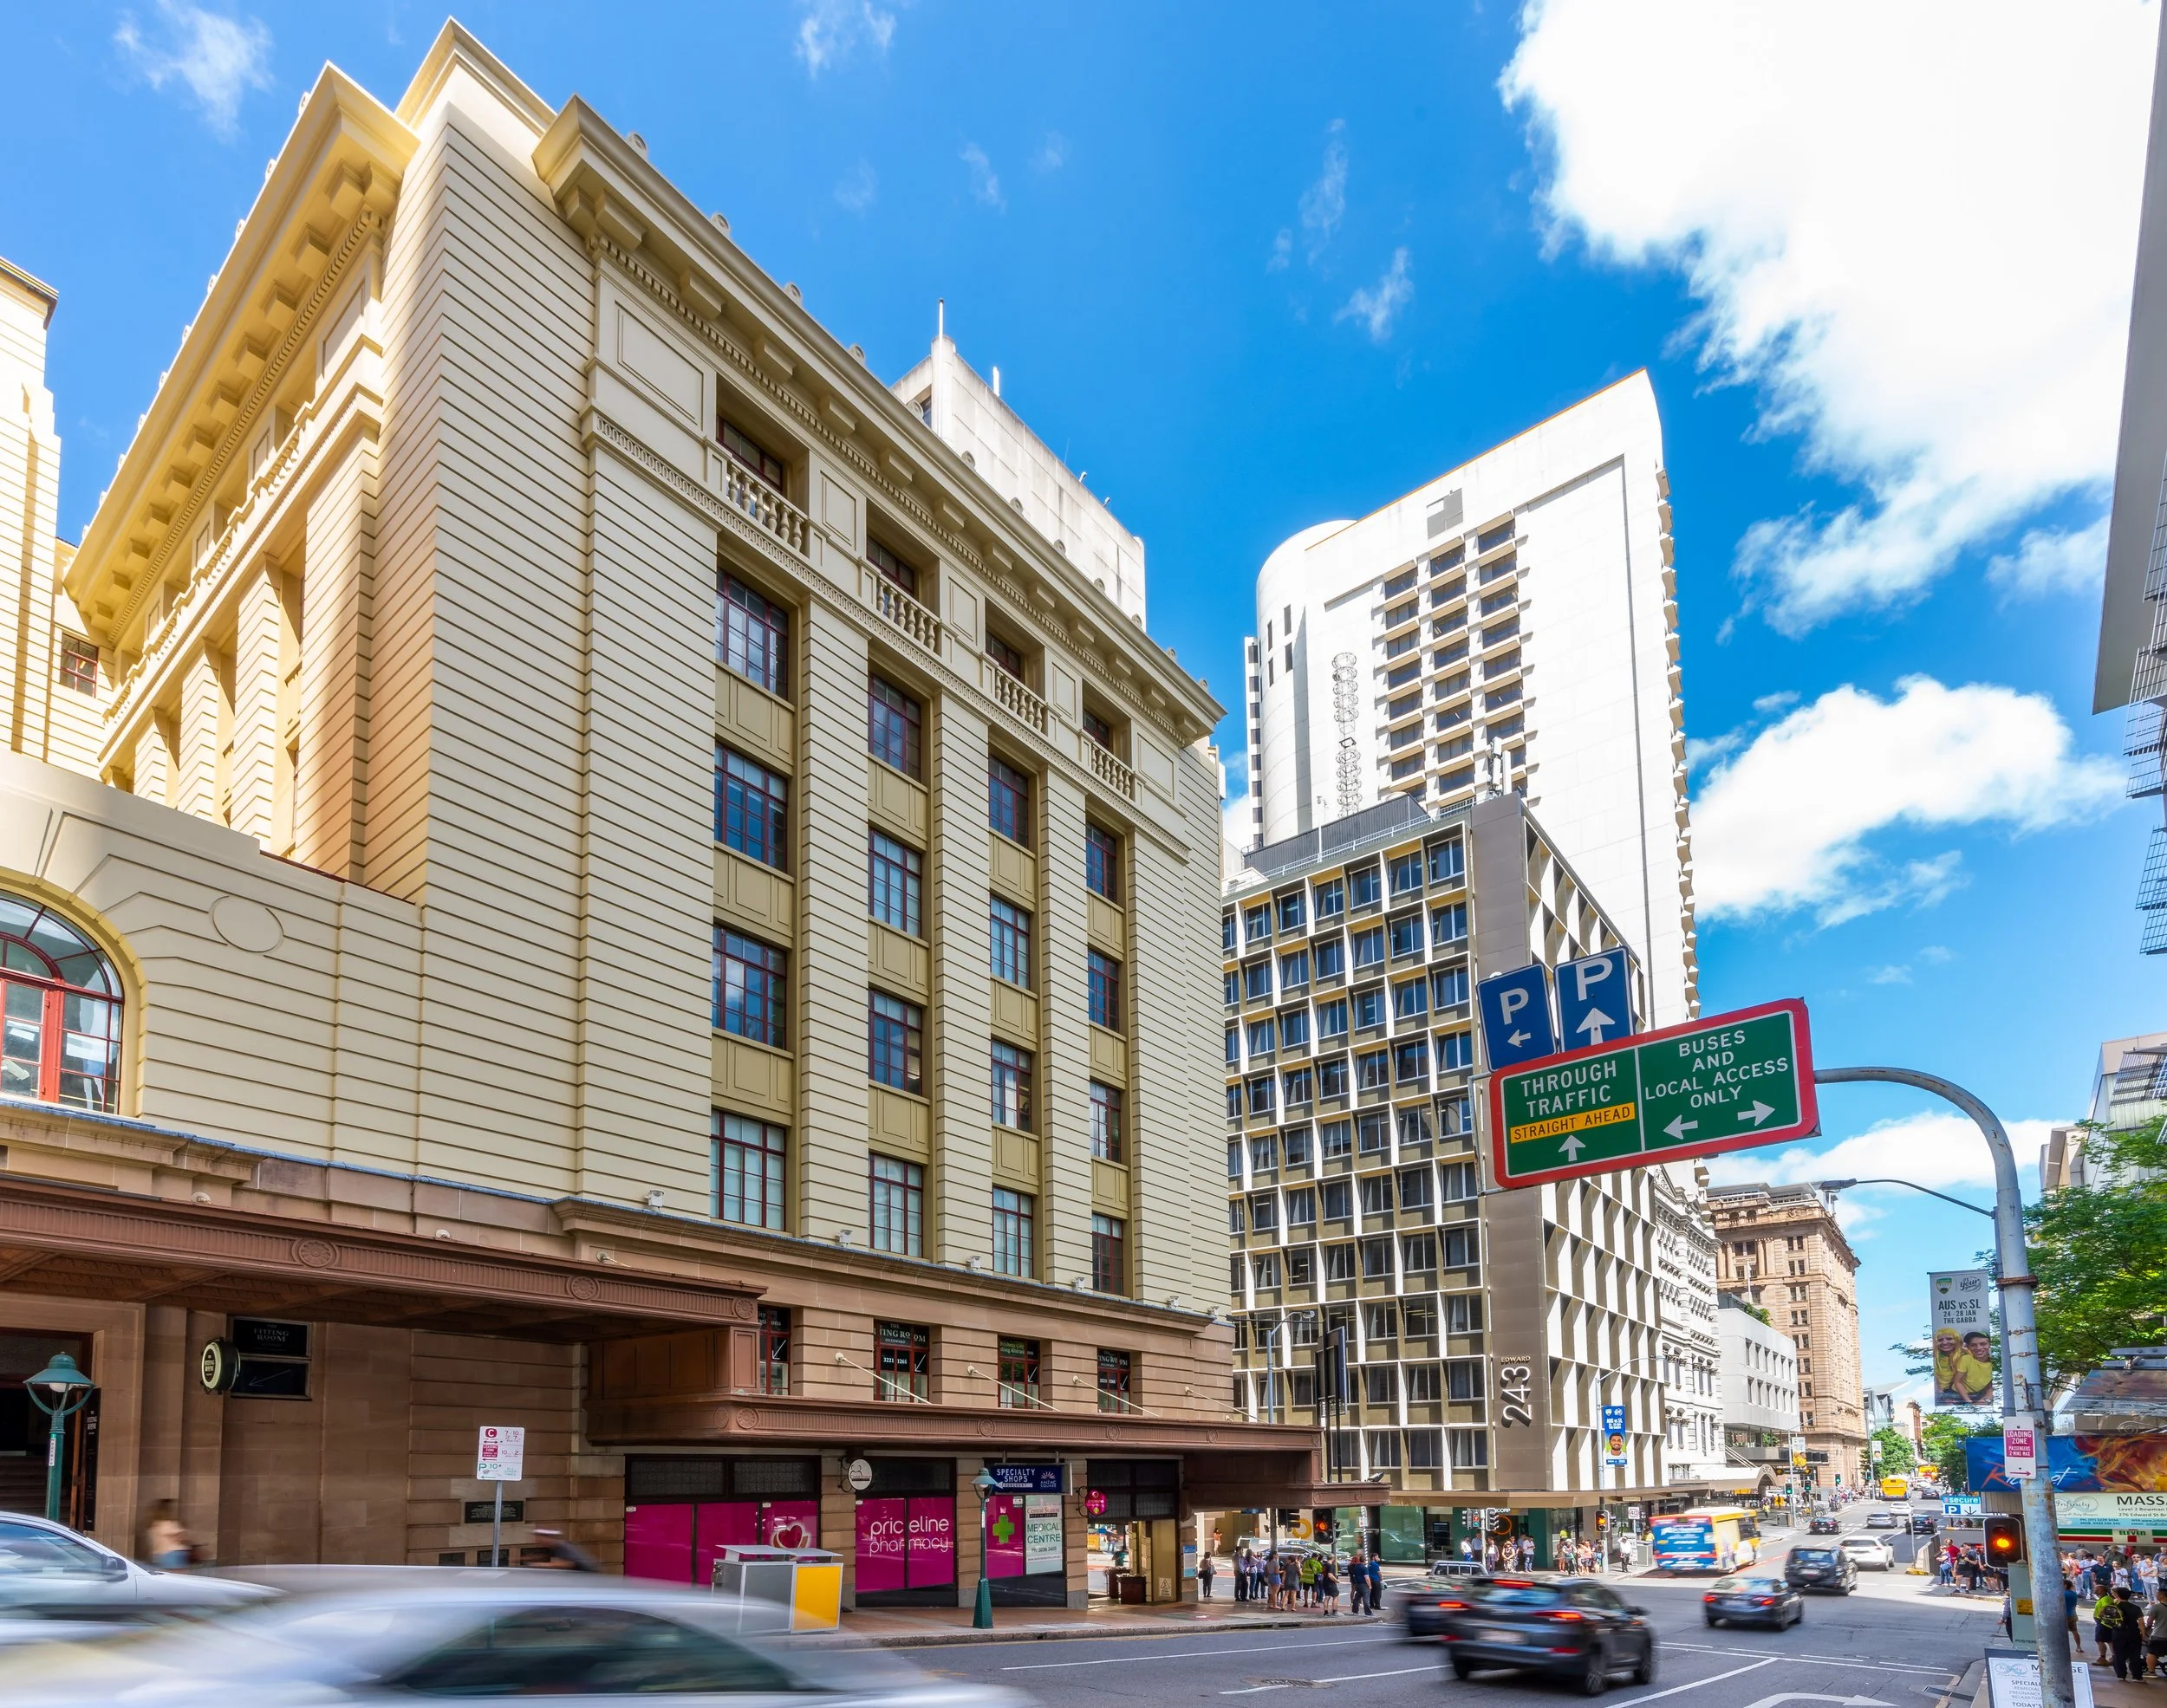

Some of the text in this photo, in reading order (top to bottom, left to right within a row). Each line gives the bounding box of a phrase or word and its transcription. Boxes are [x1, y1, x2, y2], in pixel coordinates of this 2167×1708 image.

[1576, 958, 1612, 1001] P
[1500, 988, 1528, 1025] P
[1679, 1030, 1746, 1057] BUSES
[1692, 1051, 1734, 1073] AND
[1521, 1061, 1617, 1097] THROUGH
[1645, 1057, 1788, 1101] LOCAL ACCESS
[1526, 1085, 1611, 1118] TRAFFIC
[1690, 1085, 1742, 1107] ONLY
[1514, 1107, 1630, 1140] STRAIGHT AHEAD
[1938, 1300, 1956, 1310] AUS
[1969, 1299, 1982, 1309] SL
[1501, 1355, 1531, 1364] EDWARD
[1501, 1366, 1532, 1420] 243
[2117, 1496, 2167, 1505] MASS
[871, 1516, 949, 1539] priceline
[1027, 1523, 1058, 1532] MEDICAL
[1027, 1534, 1060, 1544] CENTRE
[869, 1537, 948, 1557] pharmacy
